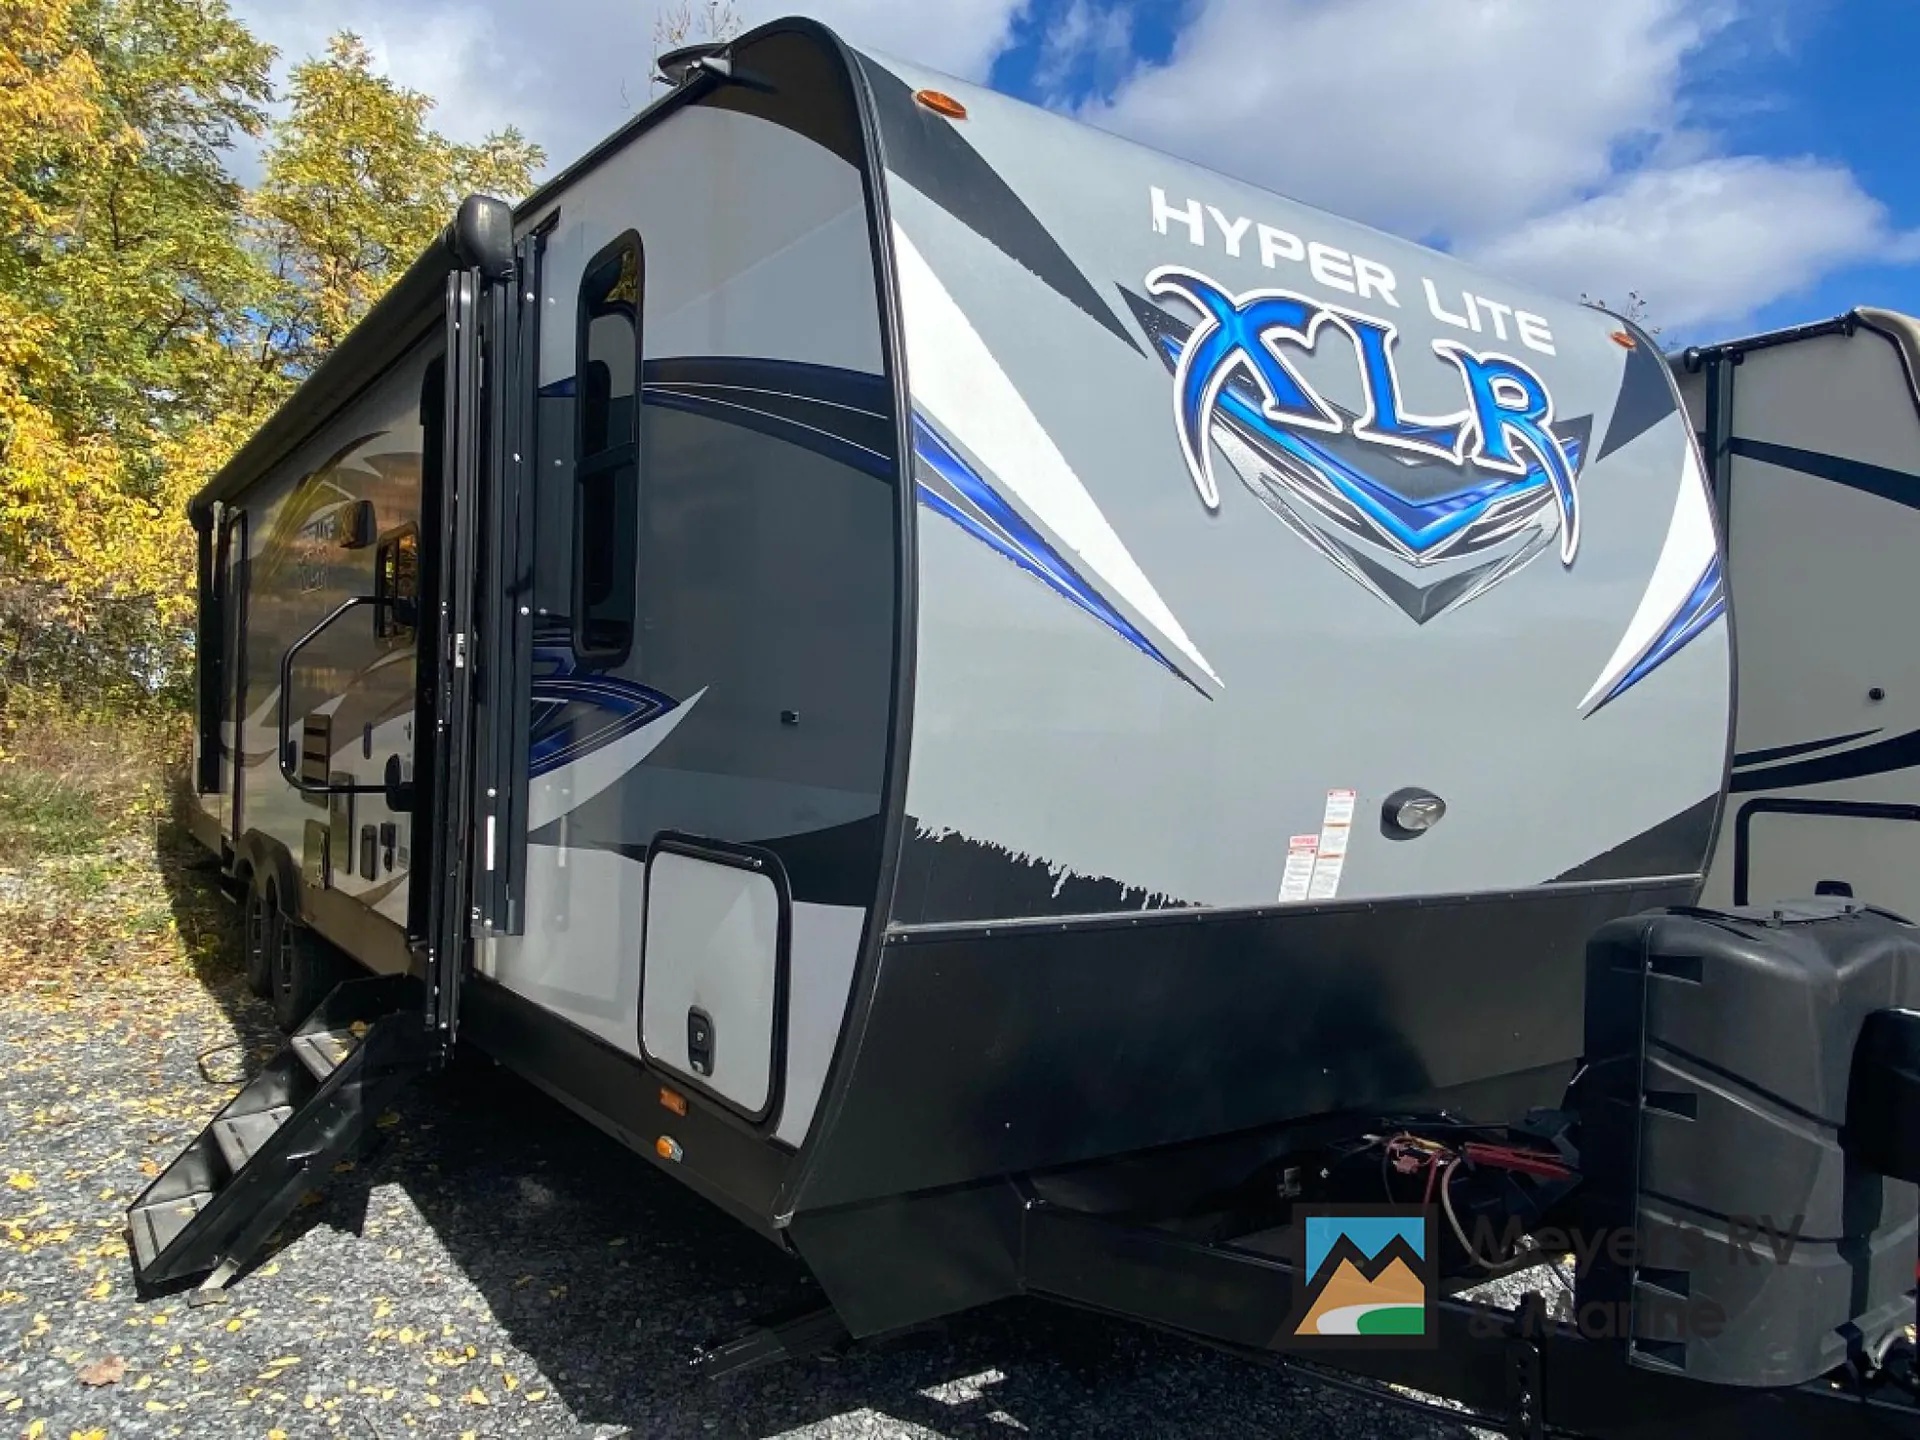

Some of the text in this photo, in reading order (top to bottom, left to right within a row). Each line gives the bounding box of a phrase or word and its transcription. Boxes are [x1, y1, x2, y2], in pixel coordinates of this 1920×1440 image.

[1150, 186, 1556, 356] HYPER LITE
[1145, 265, 1580, 567] XLR
